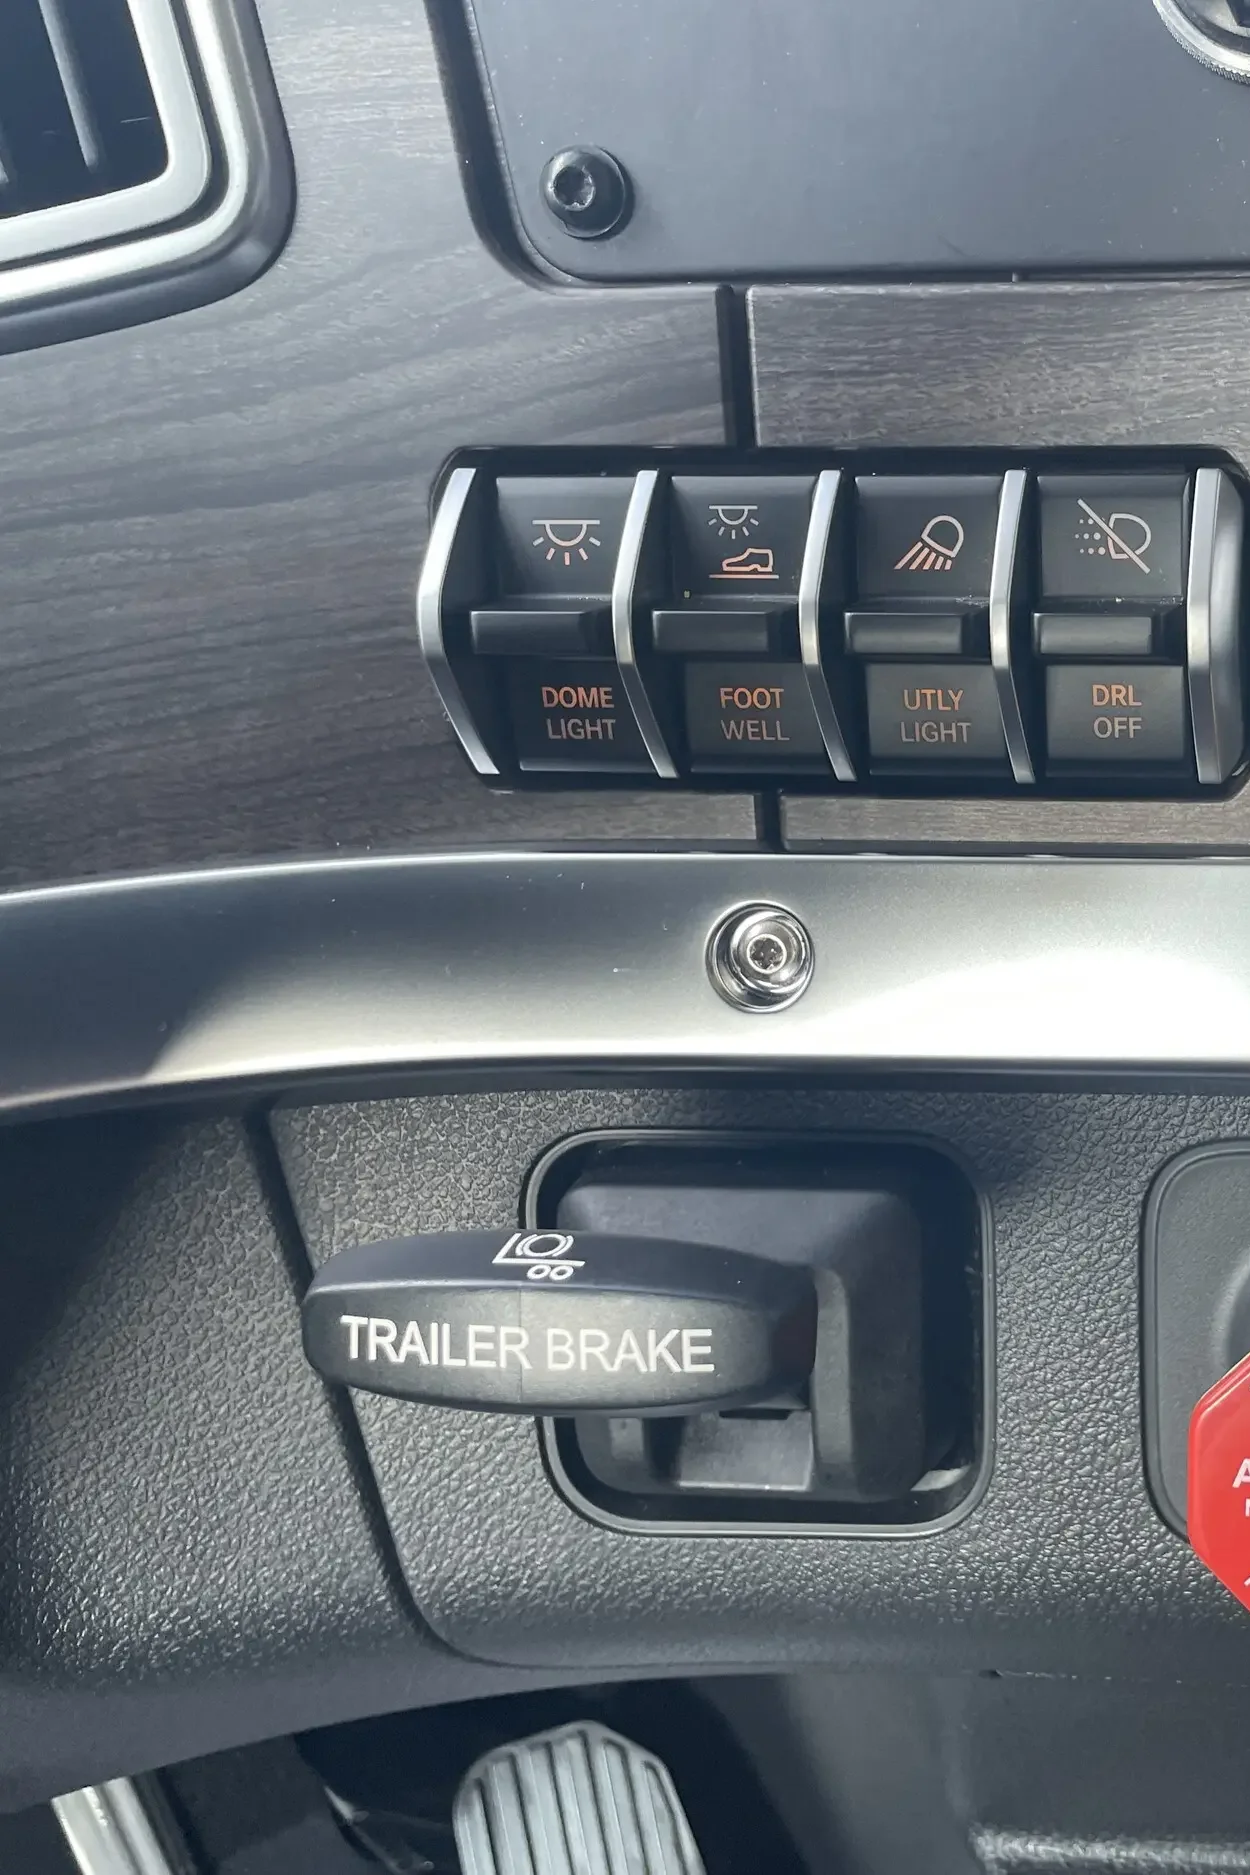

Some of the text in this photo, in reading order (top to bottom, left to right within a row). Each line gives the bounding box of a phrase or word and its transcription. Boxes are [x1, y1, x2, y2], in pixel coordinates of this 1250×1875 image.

[543, 687, 614, 707] DOME
[721, 688, 784, 708] FOOT
[905, 690, 963, 710] UTLY
[1093, 685, 1141, 705] DRL
[547, 719, 615, 739] LIGHT
[721, 720, 789, 740] WELL
[901, 722, 971, 742] LIGHT
[1094, 717, 1141, 738] OFF
[341, 1315, 714, 1372] TRAILER BRAKE
